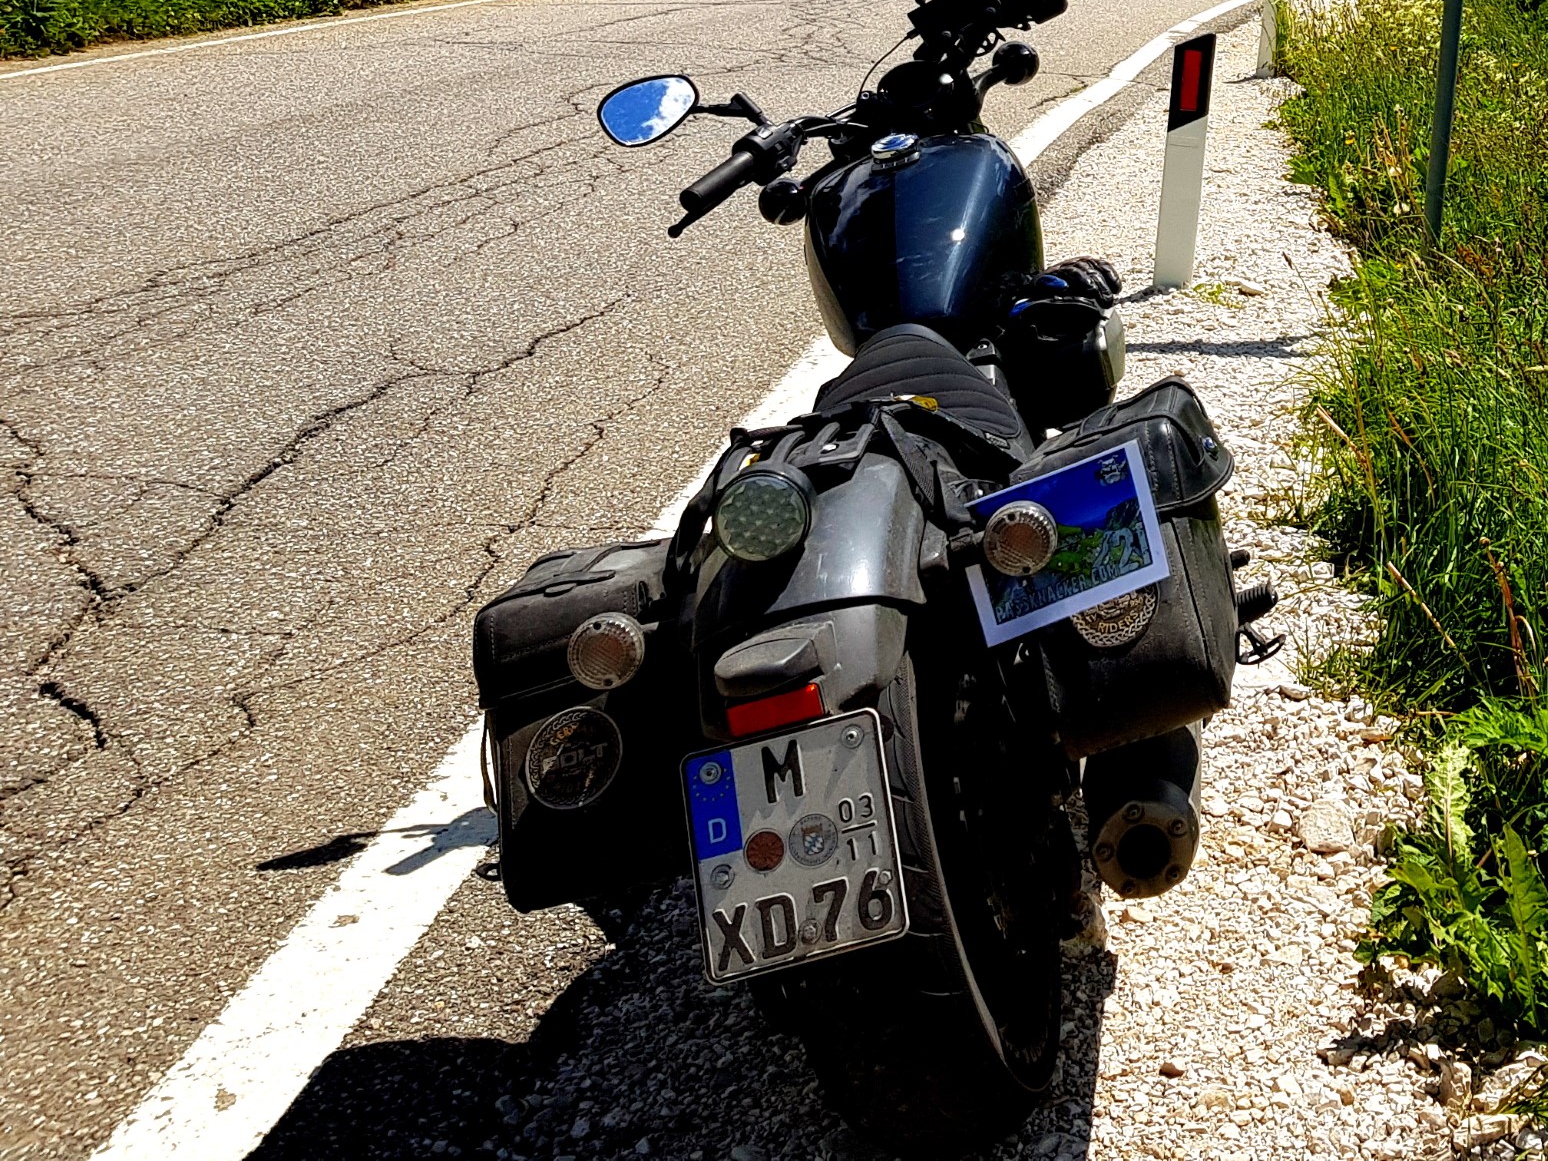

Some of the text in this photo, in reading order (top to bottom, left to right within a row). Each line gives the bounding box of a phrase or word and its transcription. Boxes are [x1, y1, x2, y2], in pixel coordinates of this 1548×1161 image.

[1097, 609, 1139, 634] RIDERS
[760, 738, 806, 804] M
[838, 792, 875, 823] 03
[707, 817, 728, 845] D
[846, 830, 879, 861] 11
